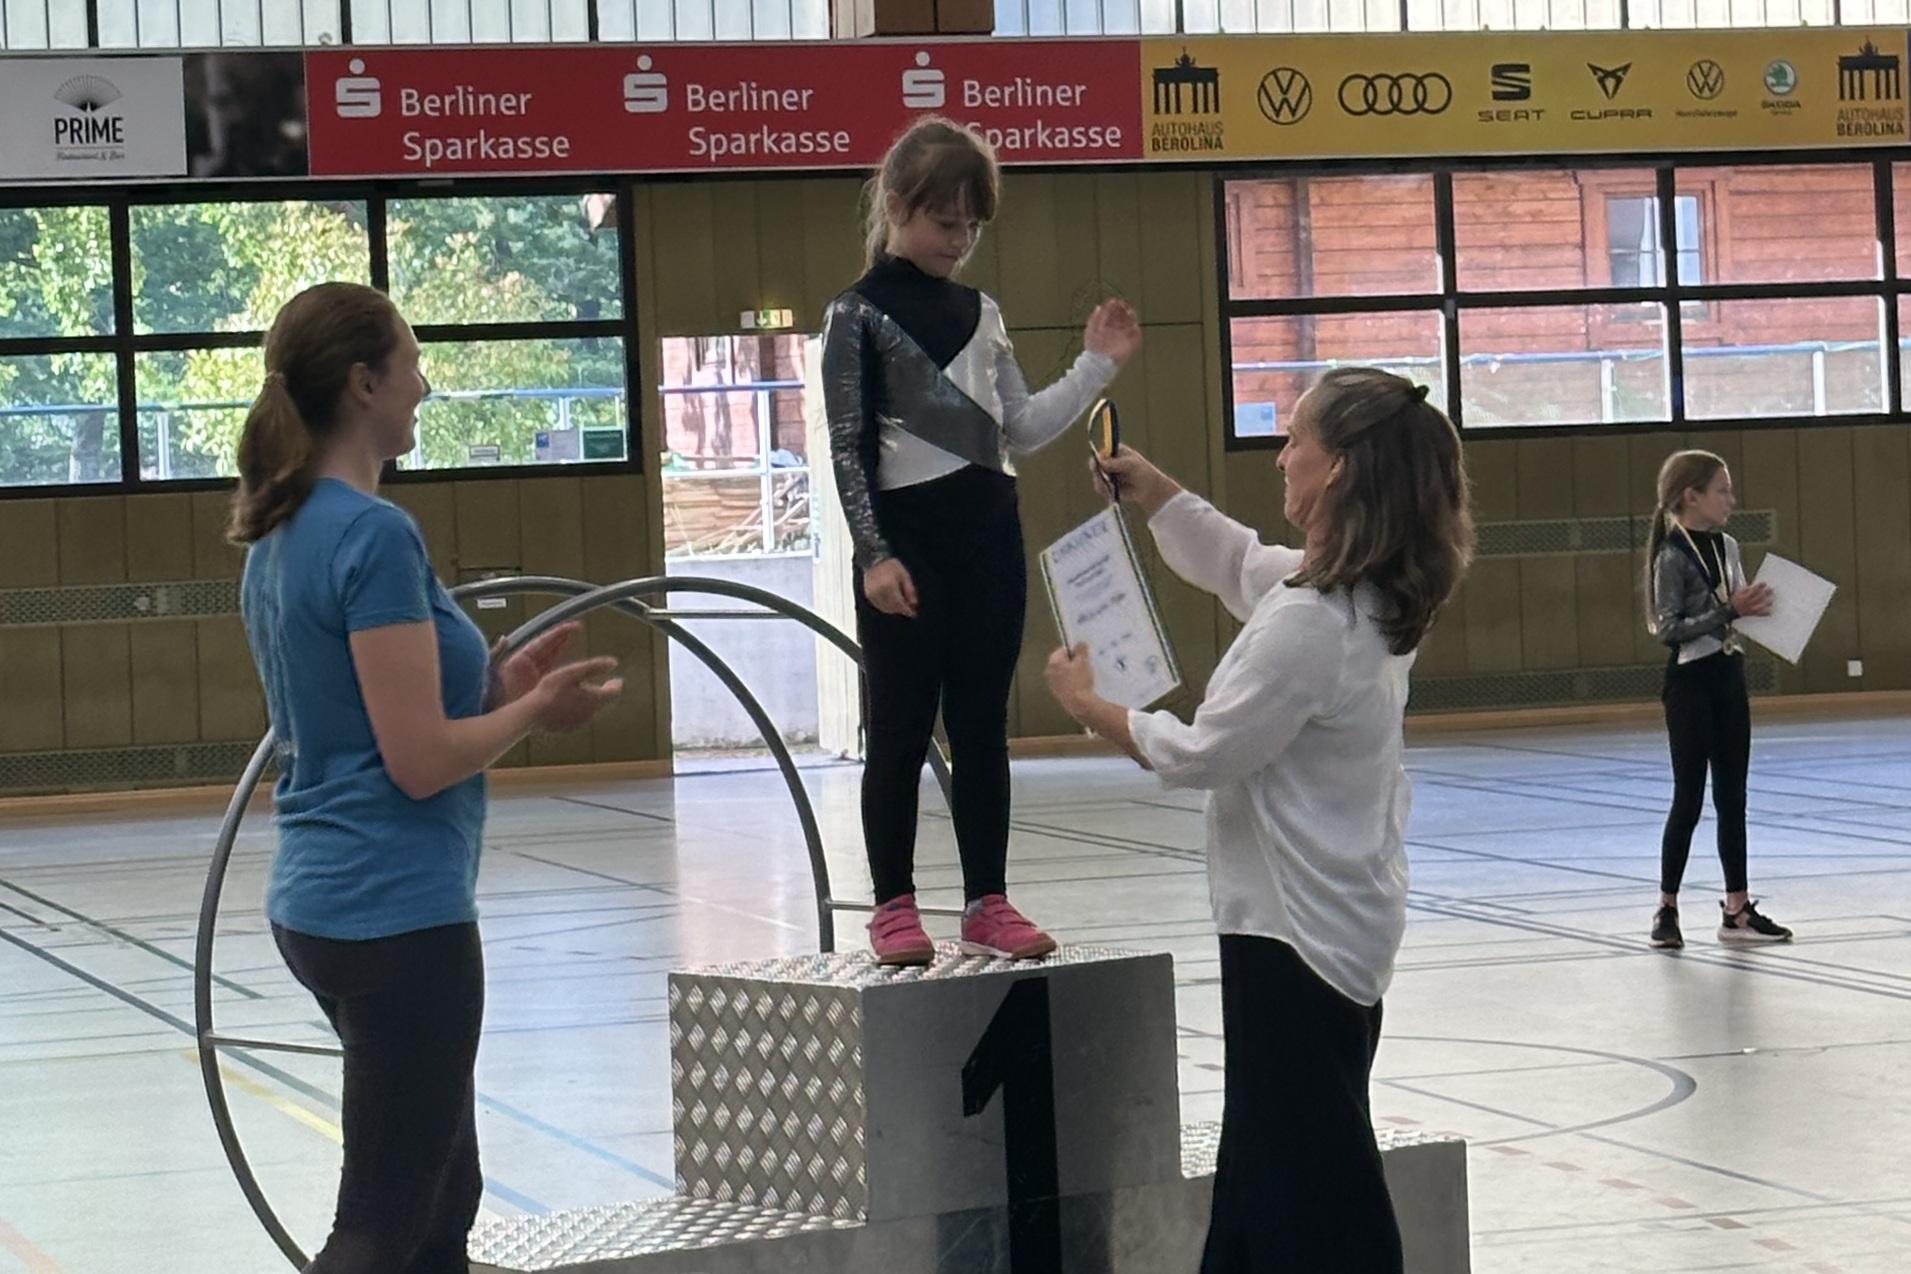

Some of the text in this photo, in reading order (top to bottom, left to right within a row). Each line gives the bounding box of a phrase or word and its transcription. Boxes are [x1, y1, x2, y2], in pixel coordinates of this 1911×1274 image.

[401, 86, 532, 117] Berliner
[686, 81, 814, 112] Berliner
[963, 77, 1087, 108] Berliner
[1151, 120, 1224, 137] AUTOHAUS
[1478, 109, 1545, 122] SEAT
[1570, 109, 1652, 120] CUPRA
[1836, 122, 1904, 137] BEROLINA
[54, 116, 124, 145] PRIME
[688, 125, 850, 162] Sparkasse
[1151, 136, 1224, 152] BEROLINA
[403, 129, 570, 168] Sparkasse
[961, 976, 1063, 1274] 1
